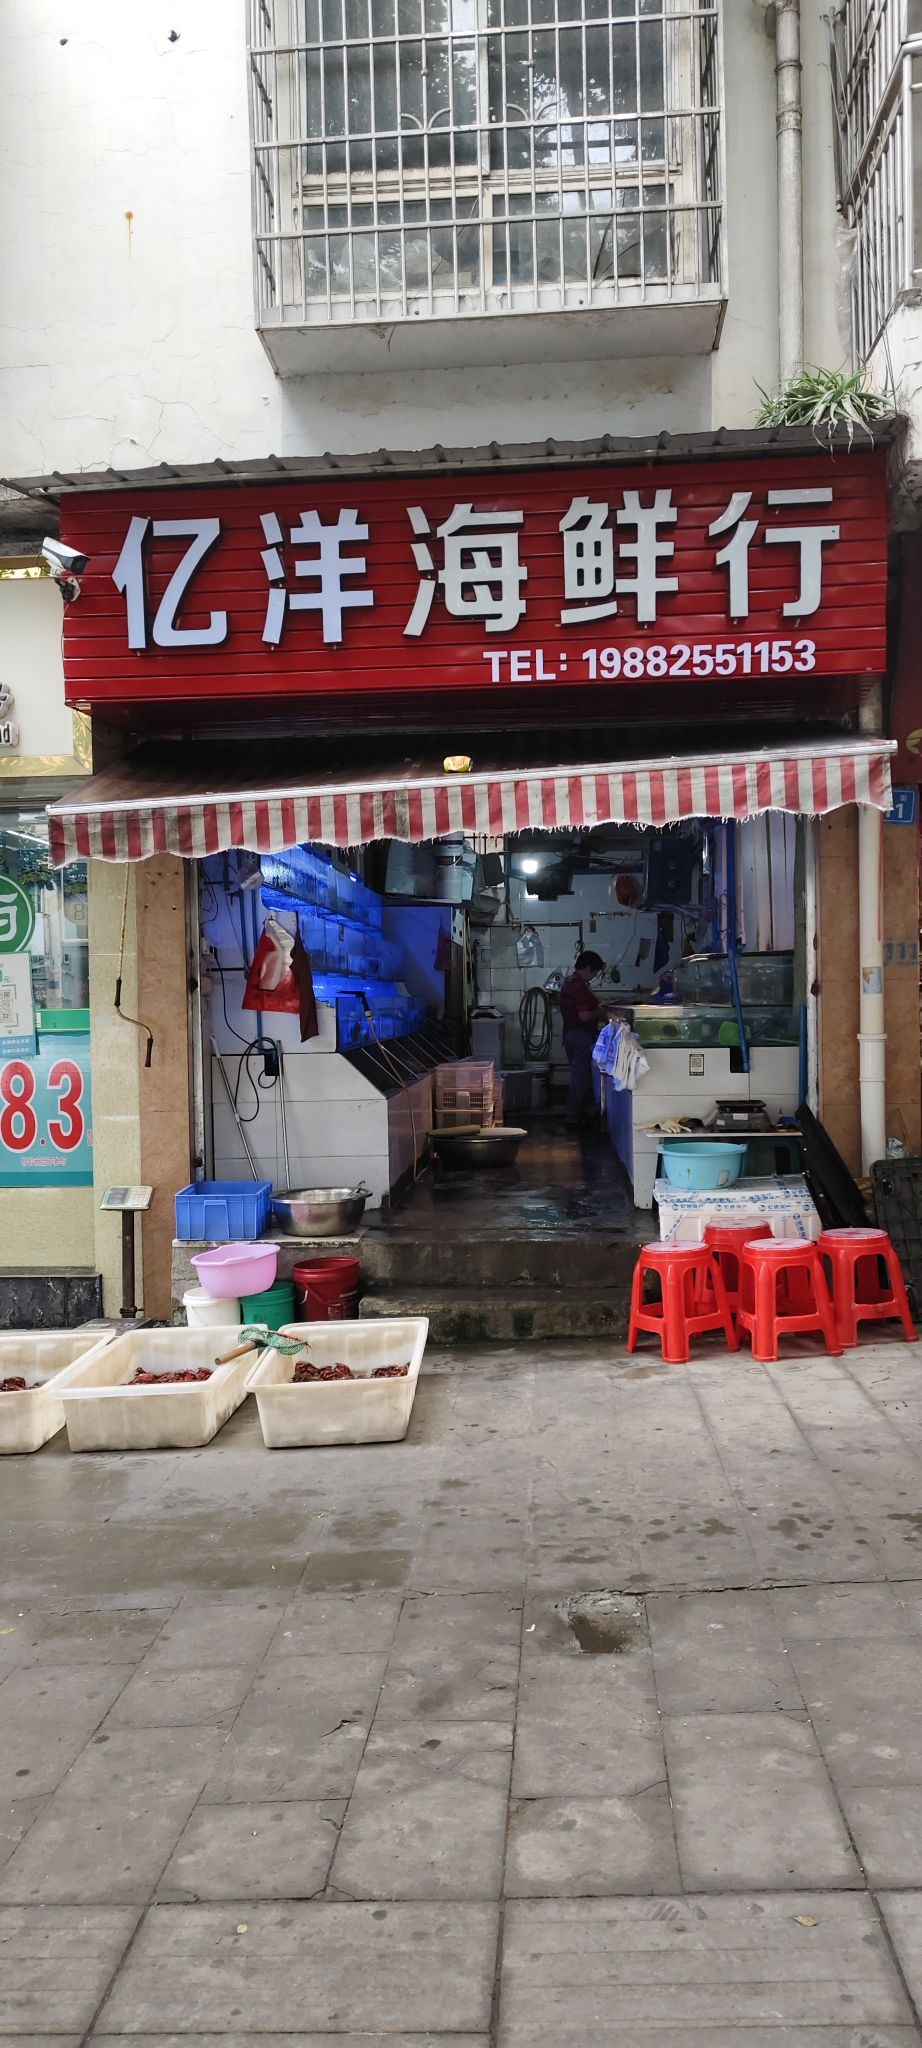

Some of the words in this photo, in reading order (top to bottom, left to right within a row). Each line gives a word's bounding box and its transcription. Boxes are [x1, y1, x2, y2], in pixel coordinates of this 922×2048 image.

[111, 487, 840, 649] 亿洋海鲜行
[483, 649, 568, 683] TEL:
[582, 640, 816, 680] 19882551153
[1, 1059, 84, 1152] 8.3
